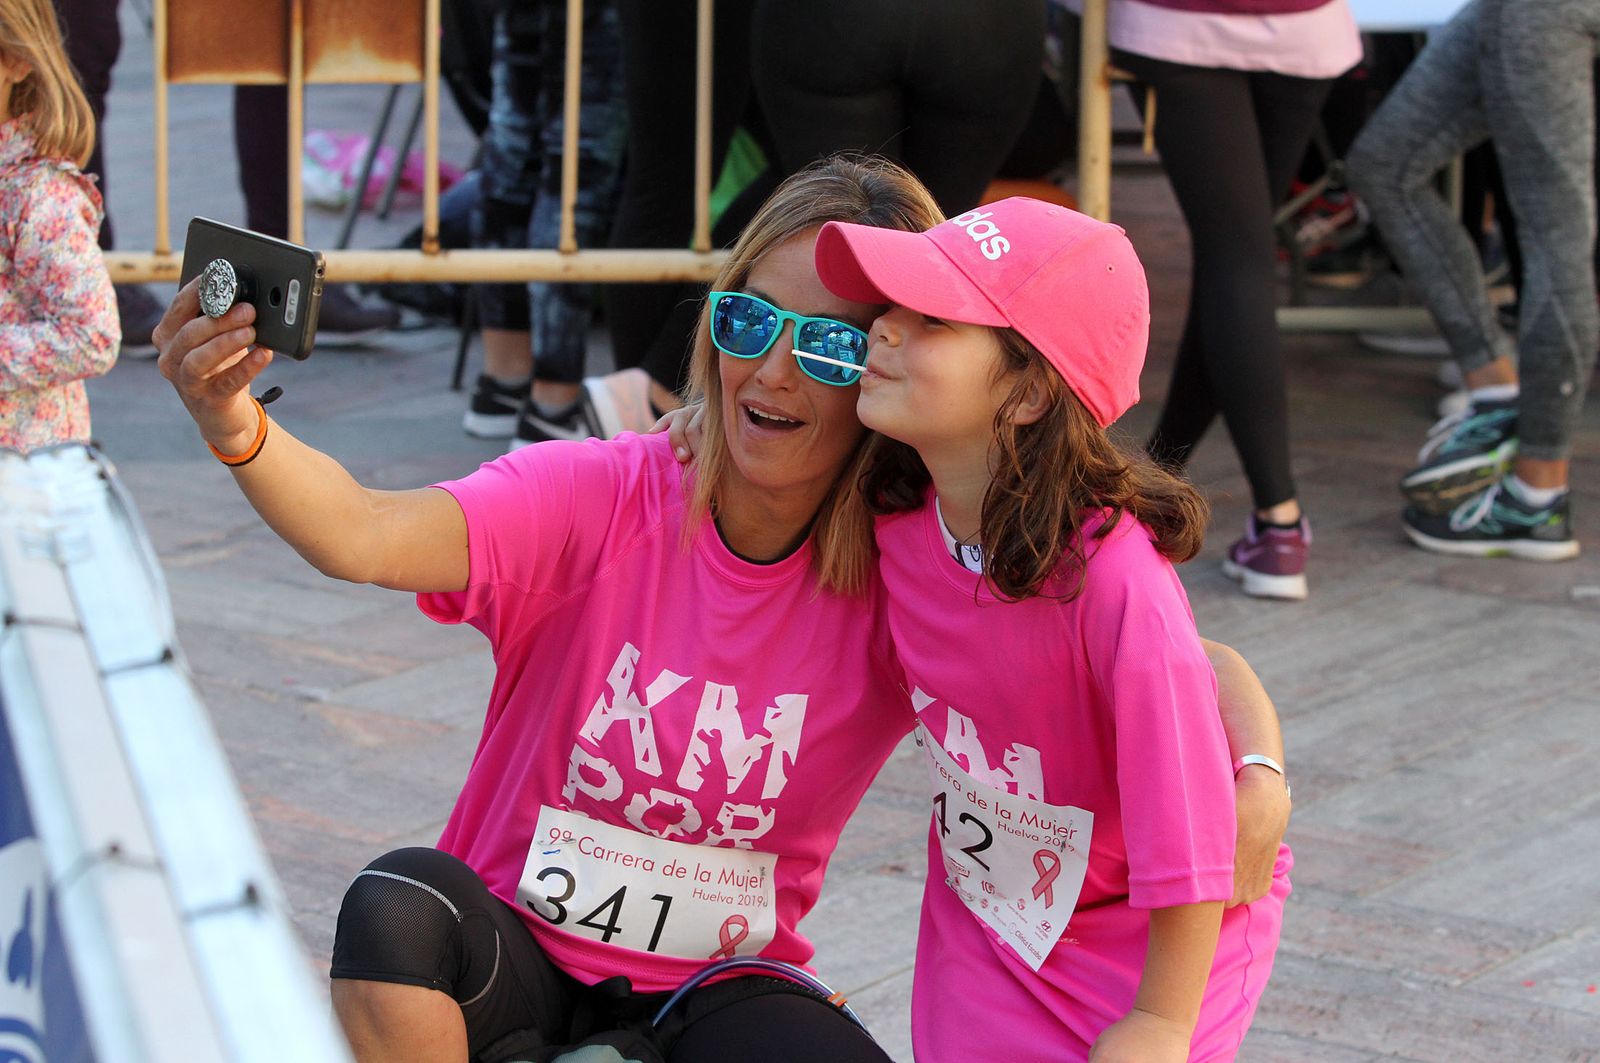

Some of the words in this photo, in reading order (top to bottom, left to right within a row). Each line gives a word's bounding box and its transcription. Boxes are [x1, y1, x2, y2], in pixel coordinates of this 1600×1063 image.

[578, 641, 809, 800] KM
[967, 790, 988, 810] de
[995, 802, 1012, 820] la
[1019, 811, 1078, 840] Mujer
[997, 820, 1040, 842] Huelva
[578, 836, 656, 872] Carrera
[662, 859, 688, 879] de
[694, 863, 712, 883] la
[717, 867, 765, 892] Mujer
[526, 866, 674, 953] 341
[692, 888, 734, 905] Huelva
[737, 894, 765, 908] 2019
